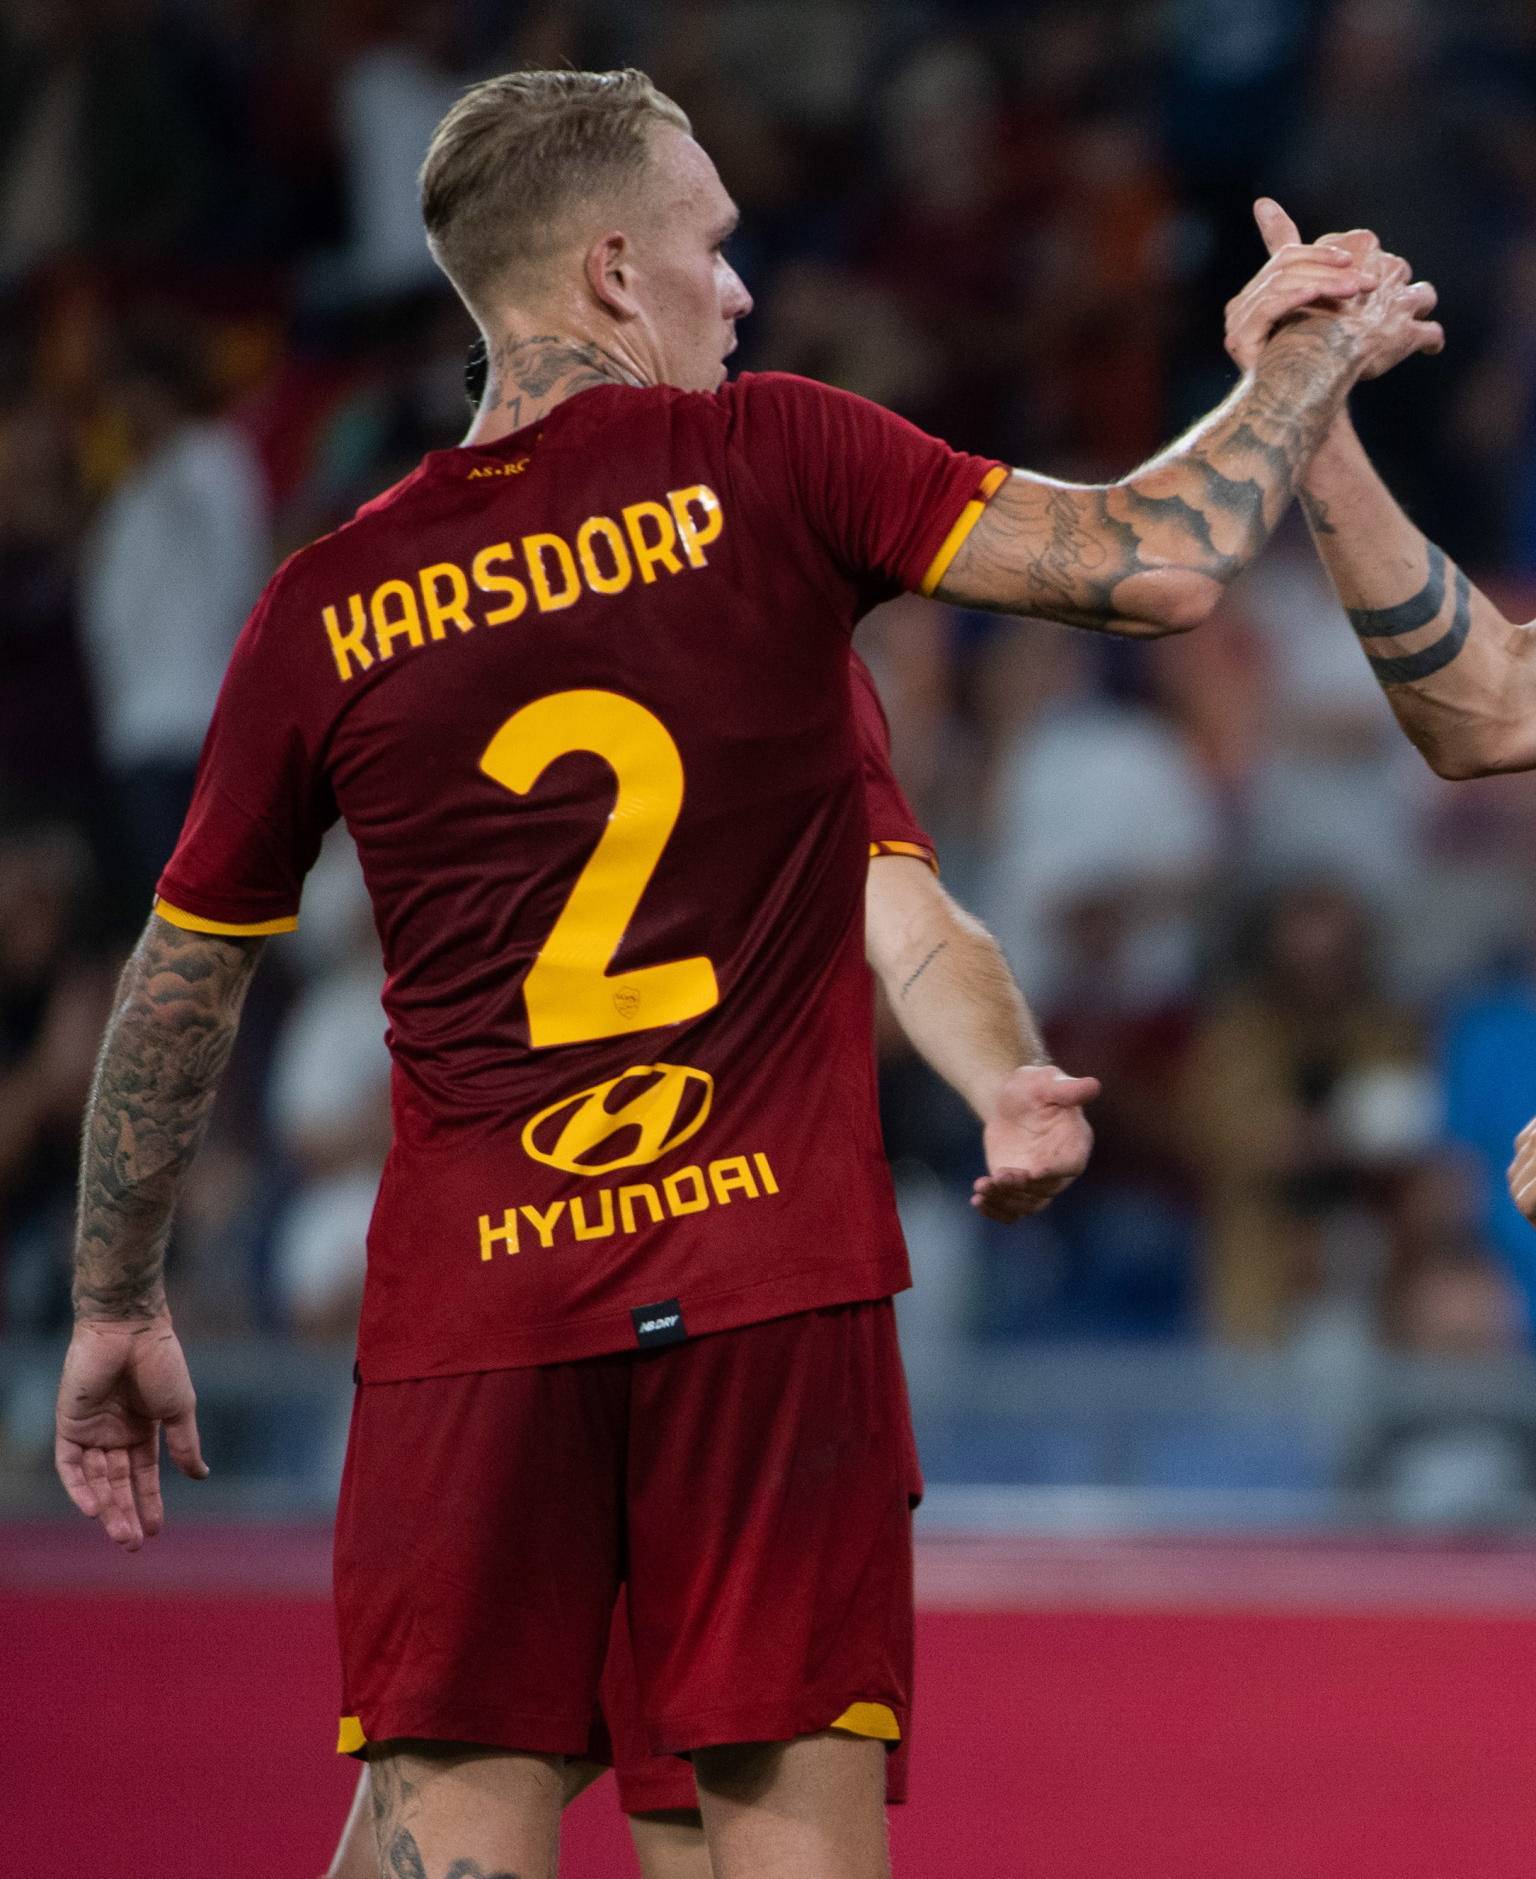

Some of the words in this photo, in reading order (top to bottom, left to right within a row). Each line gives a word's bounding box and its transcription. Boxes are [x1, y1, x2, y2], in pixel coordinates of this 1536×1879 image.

[321, 484, 724, 682] KARSDORP
[479, 688, 720, 1048] 2
[478, 1152, 780, 1262] HYUNDAI
